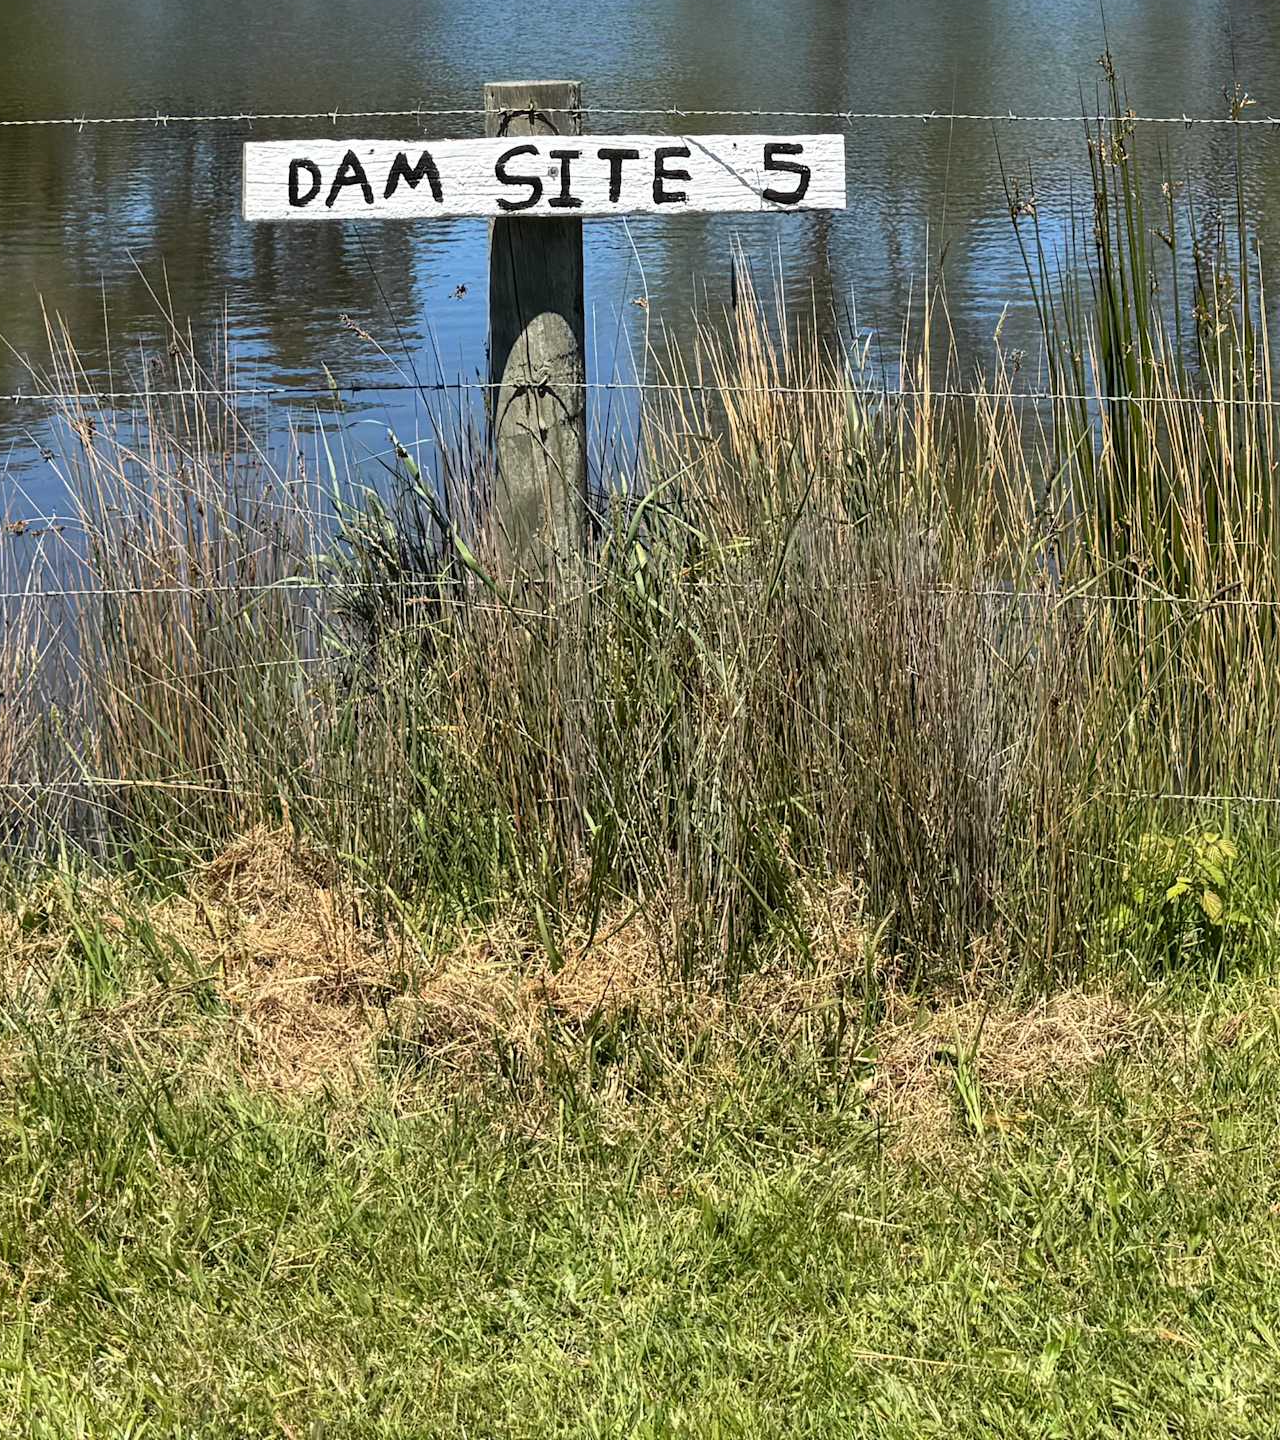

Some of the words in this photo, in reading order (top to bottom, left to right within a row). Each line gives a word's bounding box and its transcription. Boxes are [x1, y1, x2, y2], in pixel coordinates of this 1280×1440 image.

[287, 148, 444, 209] DAM
[494, 144, 693, 212] SITE
[762, 142, 812, 206] 5
